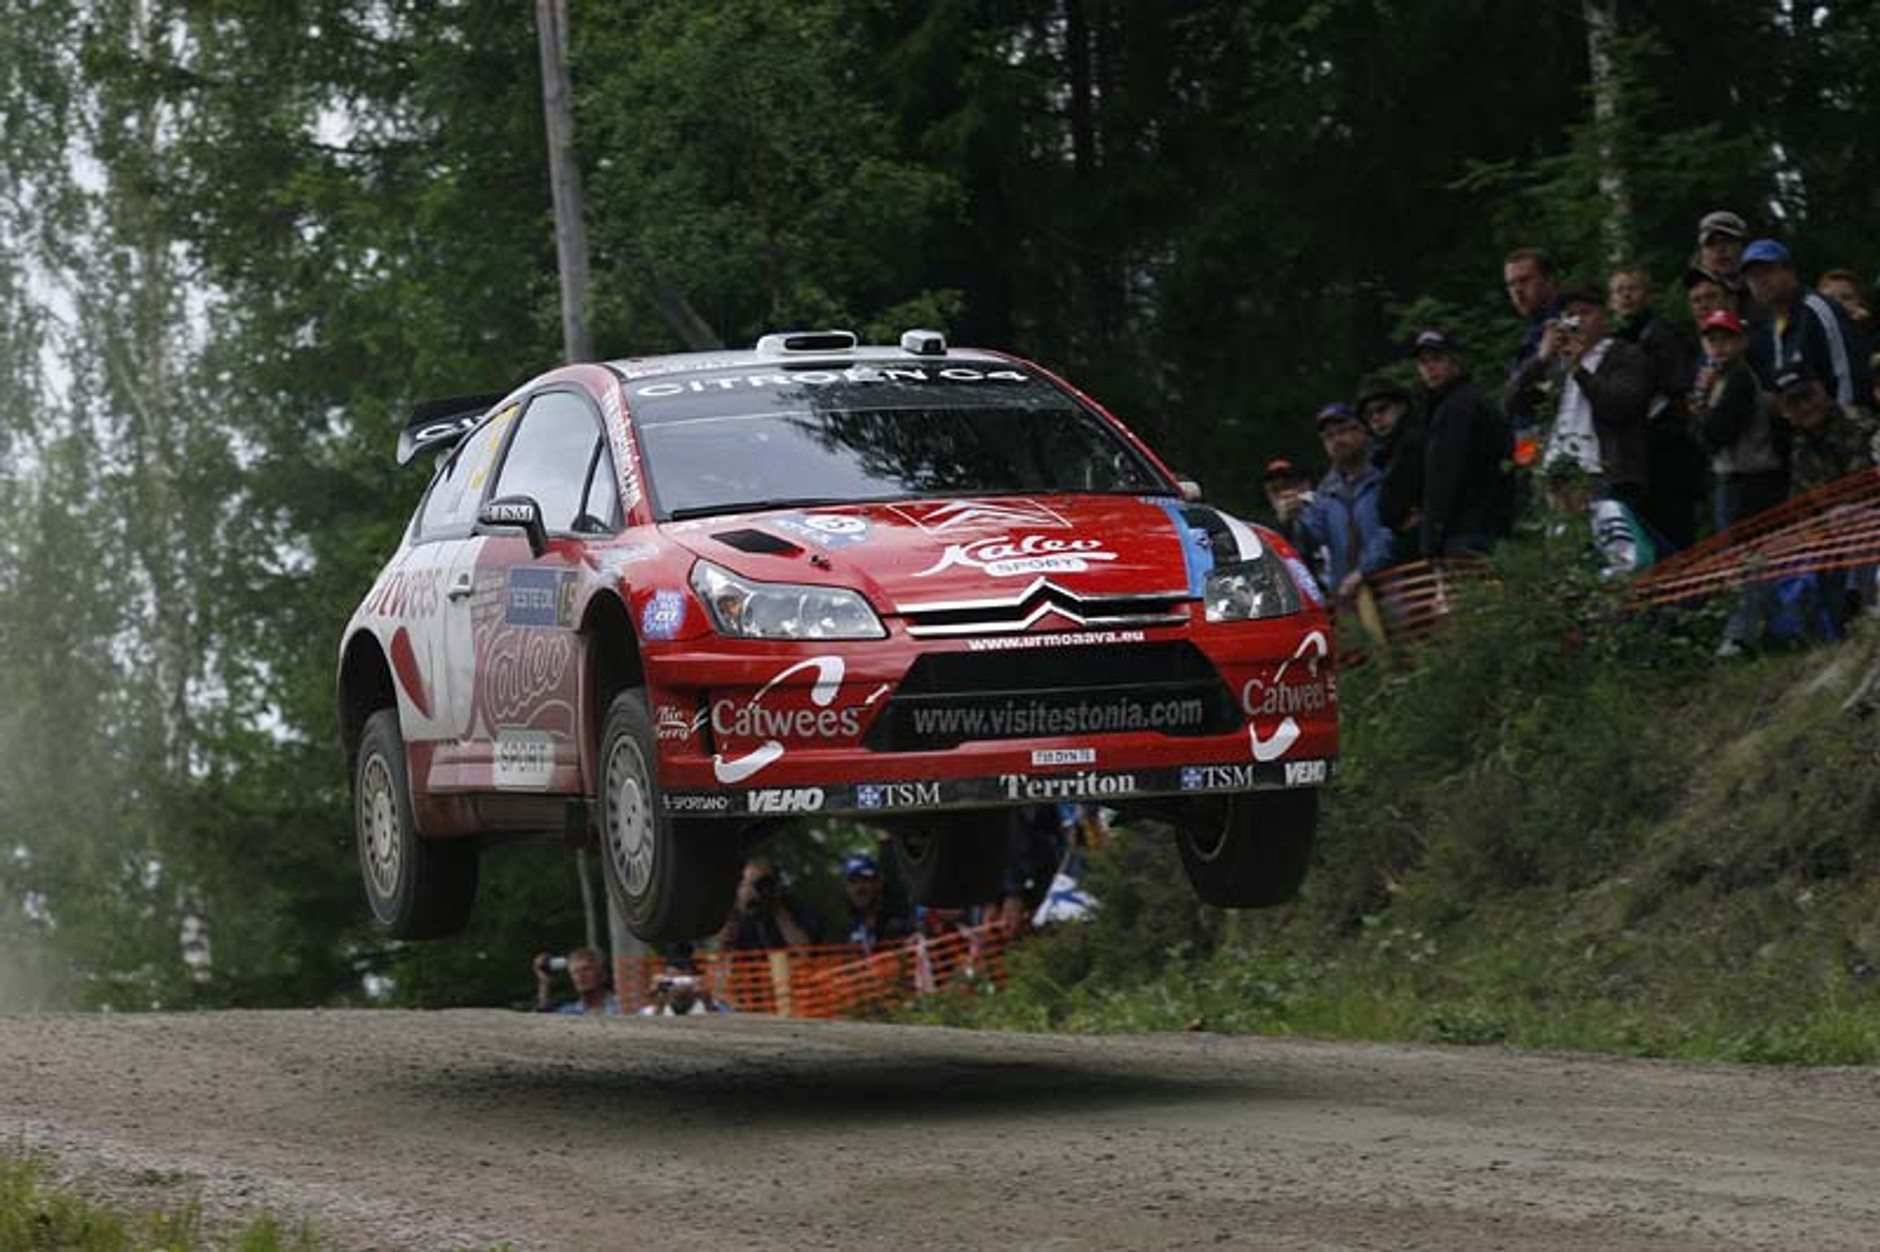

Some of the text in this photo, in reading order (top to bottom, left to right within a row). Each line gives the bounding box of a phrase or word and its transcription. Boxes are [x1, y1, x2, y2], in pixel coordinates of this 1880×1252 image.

[636, 366, 928, 398] CITROËN
[941, 367, 1029, 383] C4
[910, 535, 1112, 577] Kalev
[996, 558, 1075, 573] SPORT
[968, 630, 1145, 650] www.urmoaava.eu
[1242, 678, 1326, 716] Catwee
[711, 700, 861, 737] Catwees
[913, 698, 1203, 735] www.visitestonia.com
[747, 786, 825, 812] VEHO
[882, 781, 941, 807] TSM
[1000, 771, 1136, 799] Territon
[1202, 764, 1254, 788] TSM
